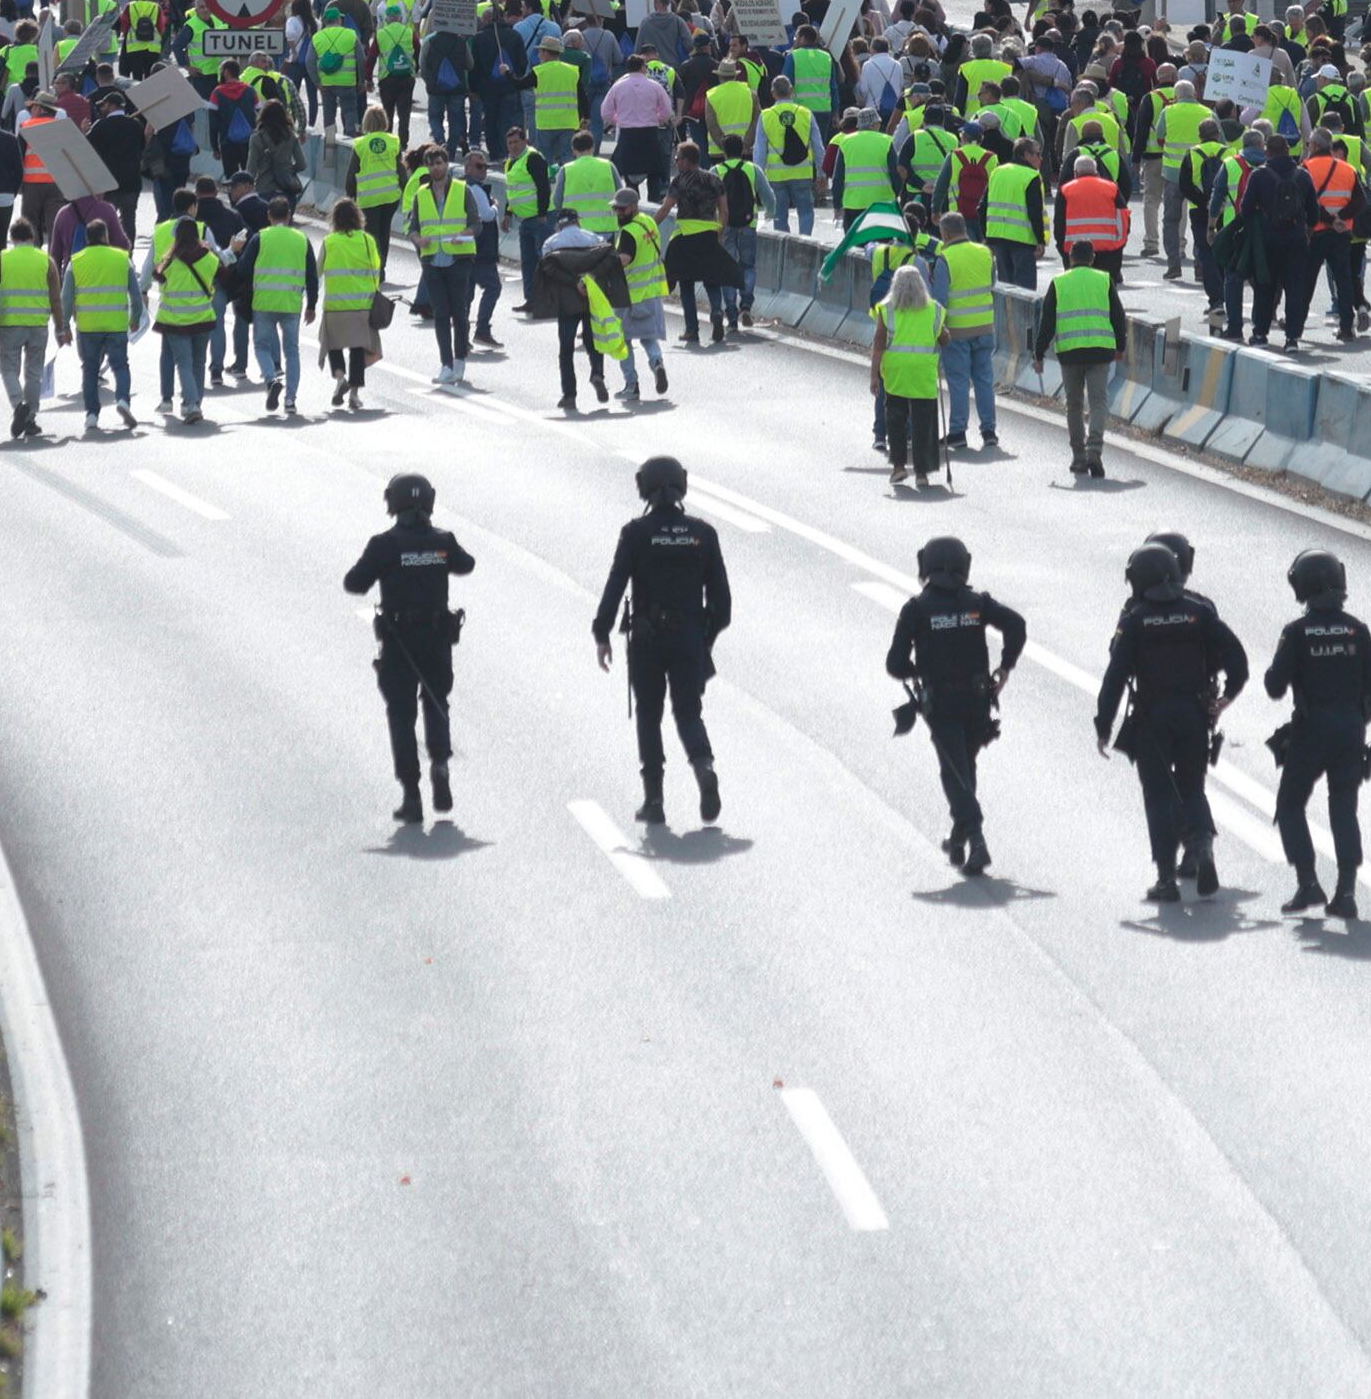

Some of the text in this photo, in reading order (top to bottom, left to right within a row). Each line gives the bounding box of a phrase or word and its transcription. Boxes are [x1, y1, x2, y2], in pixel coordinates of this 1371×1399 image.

[209, 35, 278, 51] TUNEL
[652, 536, 695, 546] POLICIA
[401, 552, 440, 561] POLICIA
[401, 558, 446, 567] NACIONAL
[1143, 615, 1190, 627] POLICIA
[1305, 626, 1350, 636] POLICIA
[1310, 646, 1347, 657] U.I.P.
